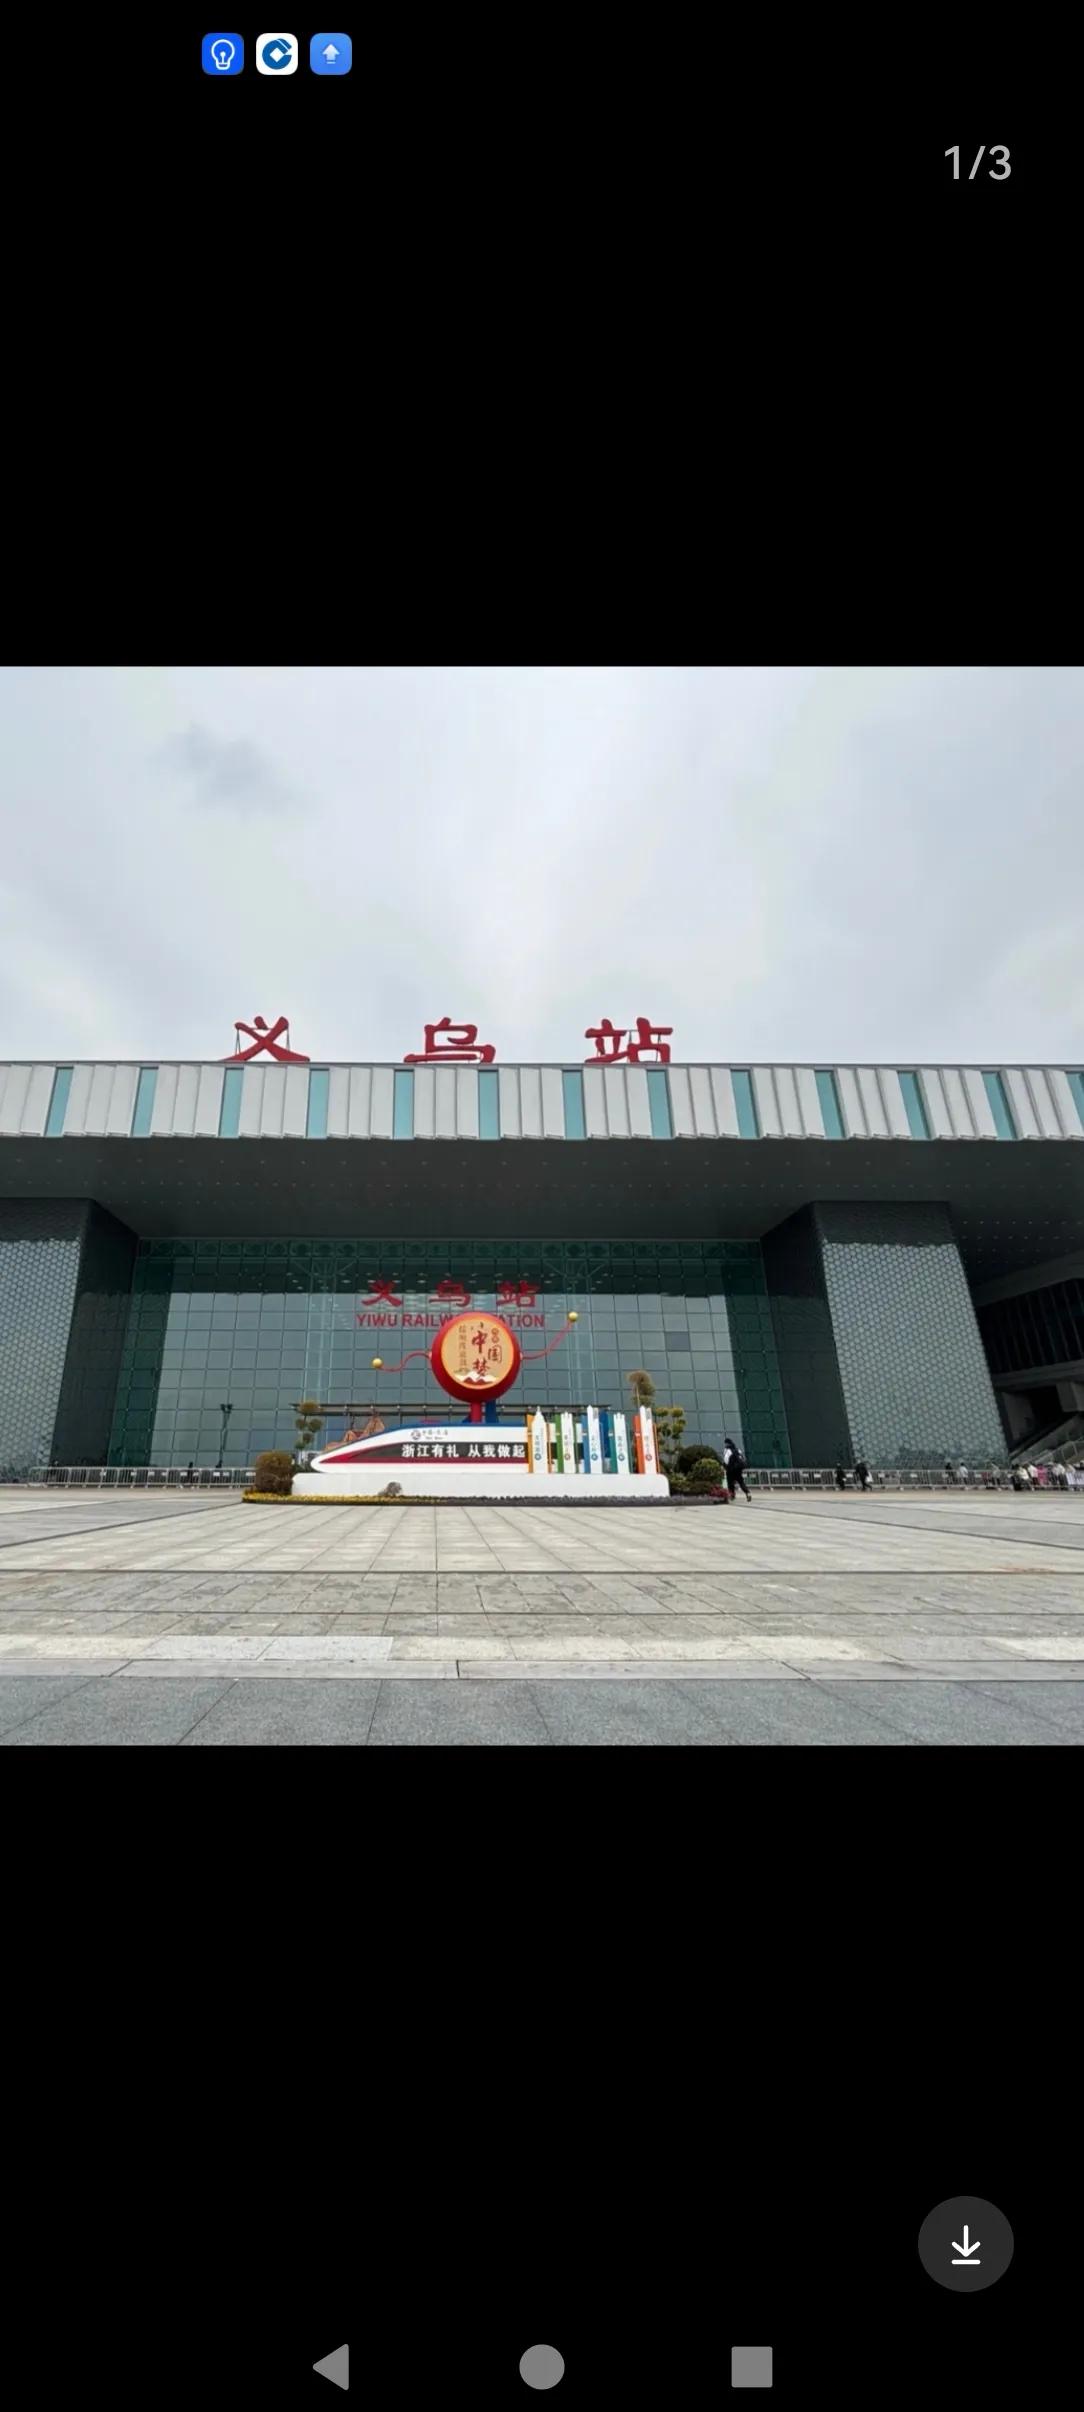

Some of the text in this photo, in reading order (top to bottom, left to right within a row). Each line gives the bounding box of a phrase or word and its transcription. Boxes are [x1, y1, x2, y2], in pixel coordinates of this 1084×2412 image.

[219, 1016, 673, 1063] 义乌站
[362, 1280, 540, 1308] 义乌站
[357, 1313, 398, 1327] YIWU
[402, 1444, 525, 1457] 浙江有礼 从我做起
